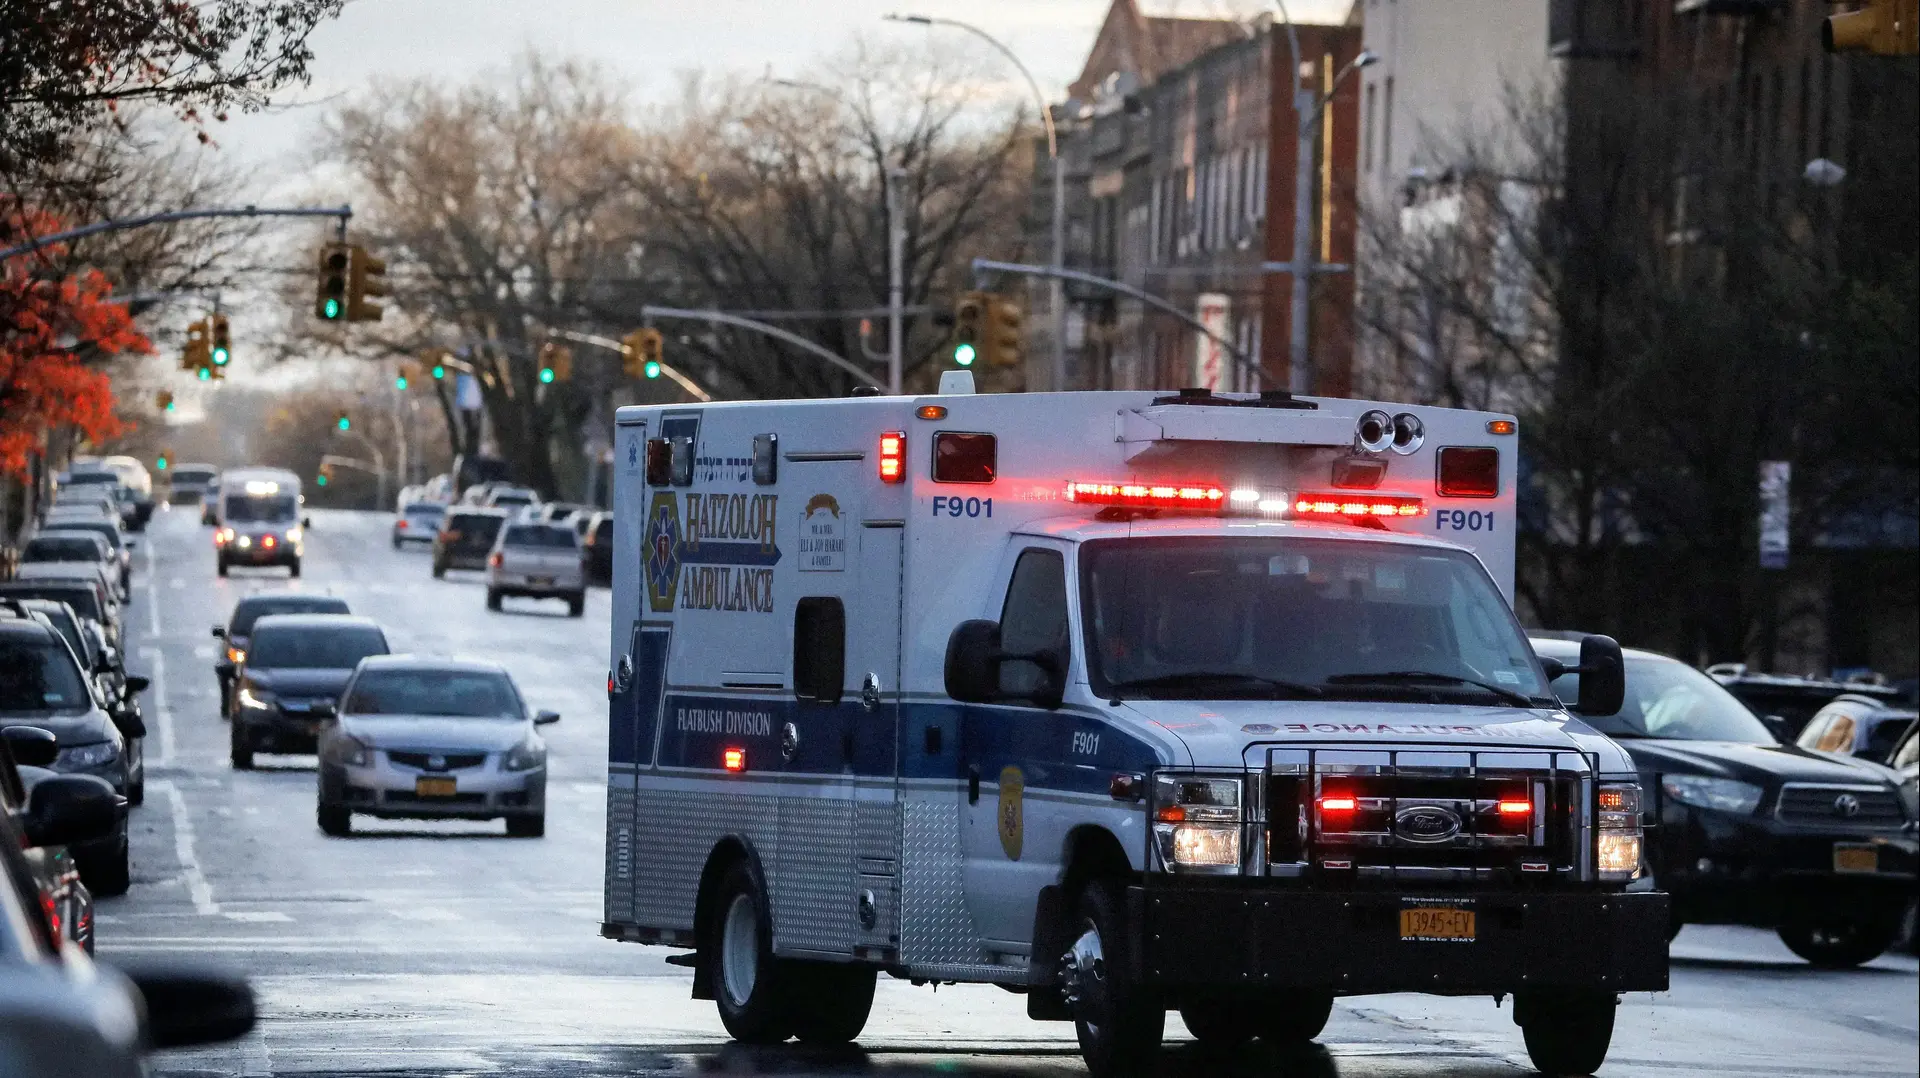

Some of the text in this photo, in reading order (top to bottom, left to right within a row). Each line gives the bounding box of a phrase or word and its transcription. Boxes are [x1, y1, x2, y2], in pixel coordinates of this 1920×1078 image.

[932, 496, 993, 518] F901
[686, 493, 778, 555] HATZOLOH
[1436, 509, 1494, 531] F901
[681, 566, 774, 613] AMBULANCE
[677, 708, 771, 736] FLATBUSH DIVISION
[1072, 731, 1100, 755] F901
[1414, 815, 1444, 829] Ford
